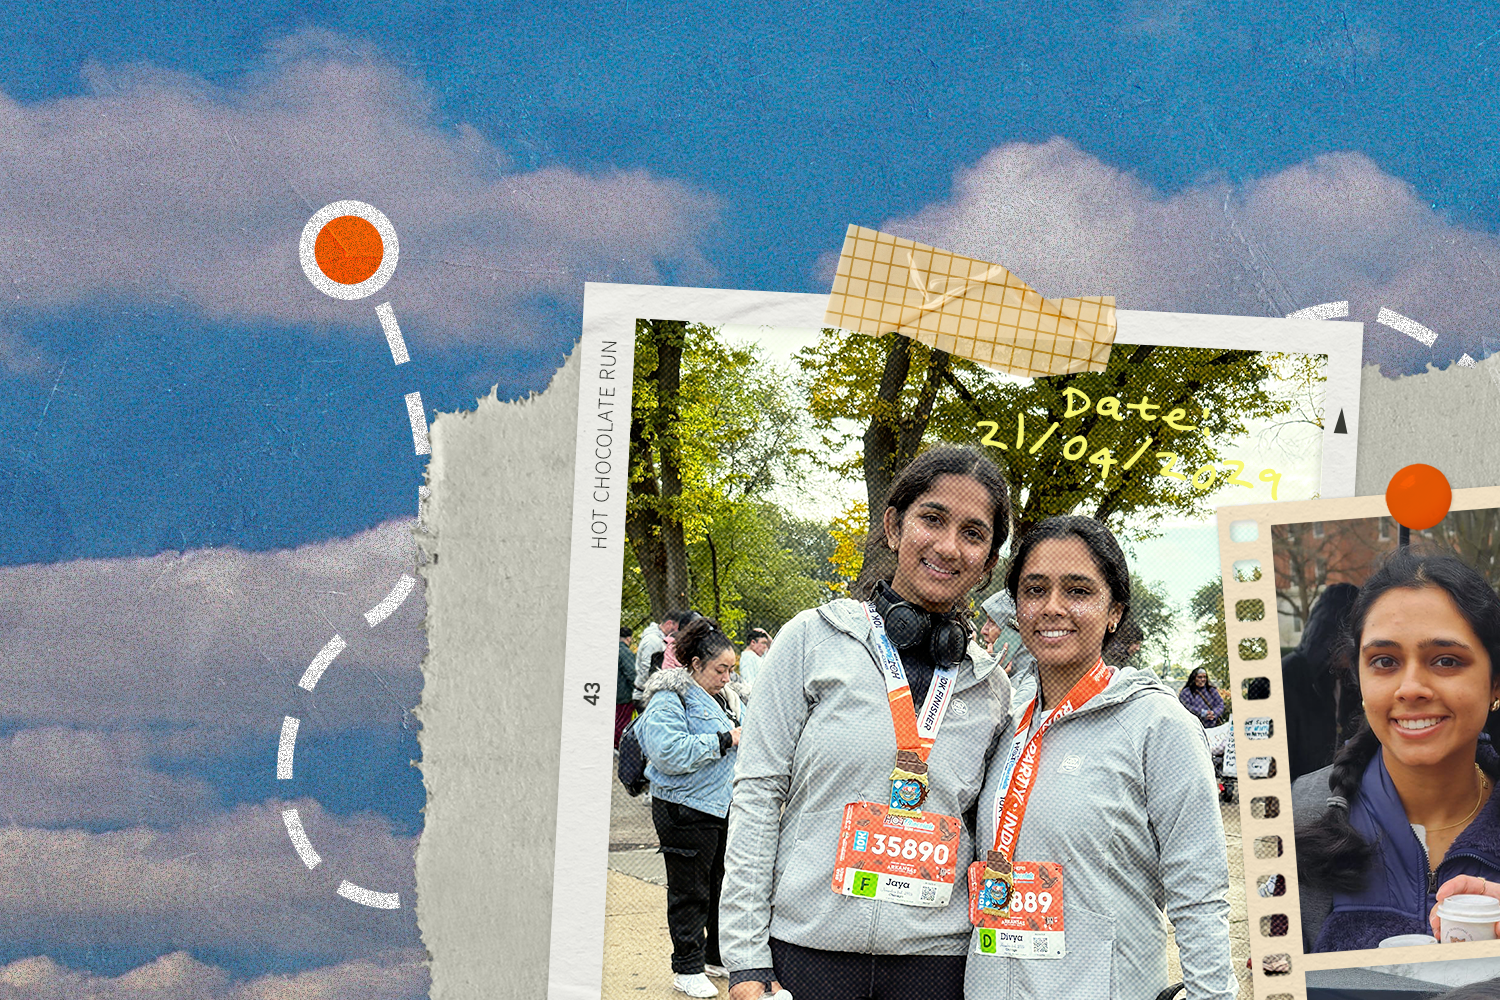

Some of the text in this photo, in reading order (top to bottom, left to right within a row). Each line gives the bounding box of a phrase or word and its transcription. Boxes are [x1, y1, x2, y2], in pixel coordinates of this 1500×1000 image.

[1062, 386, 1211, 437] Date:
[976, 412, 1283, 501] 21/04/2029
[924, 687, 945, 731] FINISHER
[1011, 740, 1037, 802] PARTY
[855, 831, 868, 850] 10K
[871, 833, 950, 865] 35890
[860, 877, 871, 891] F
[885, 878, 910, 890] Jaya
[1011, 891, 1053, 913] 889
[983, 934, 992, 948] D
[1000, 932, 1023, 943] Divya
